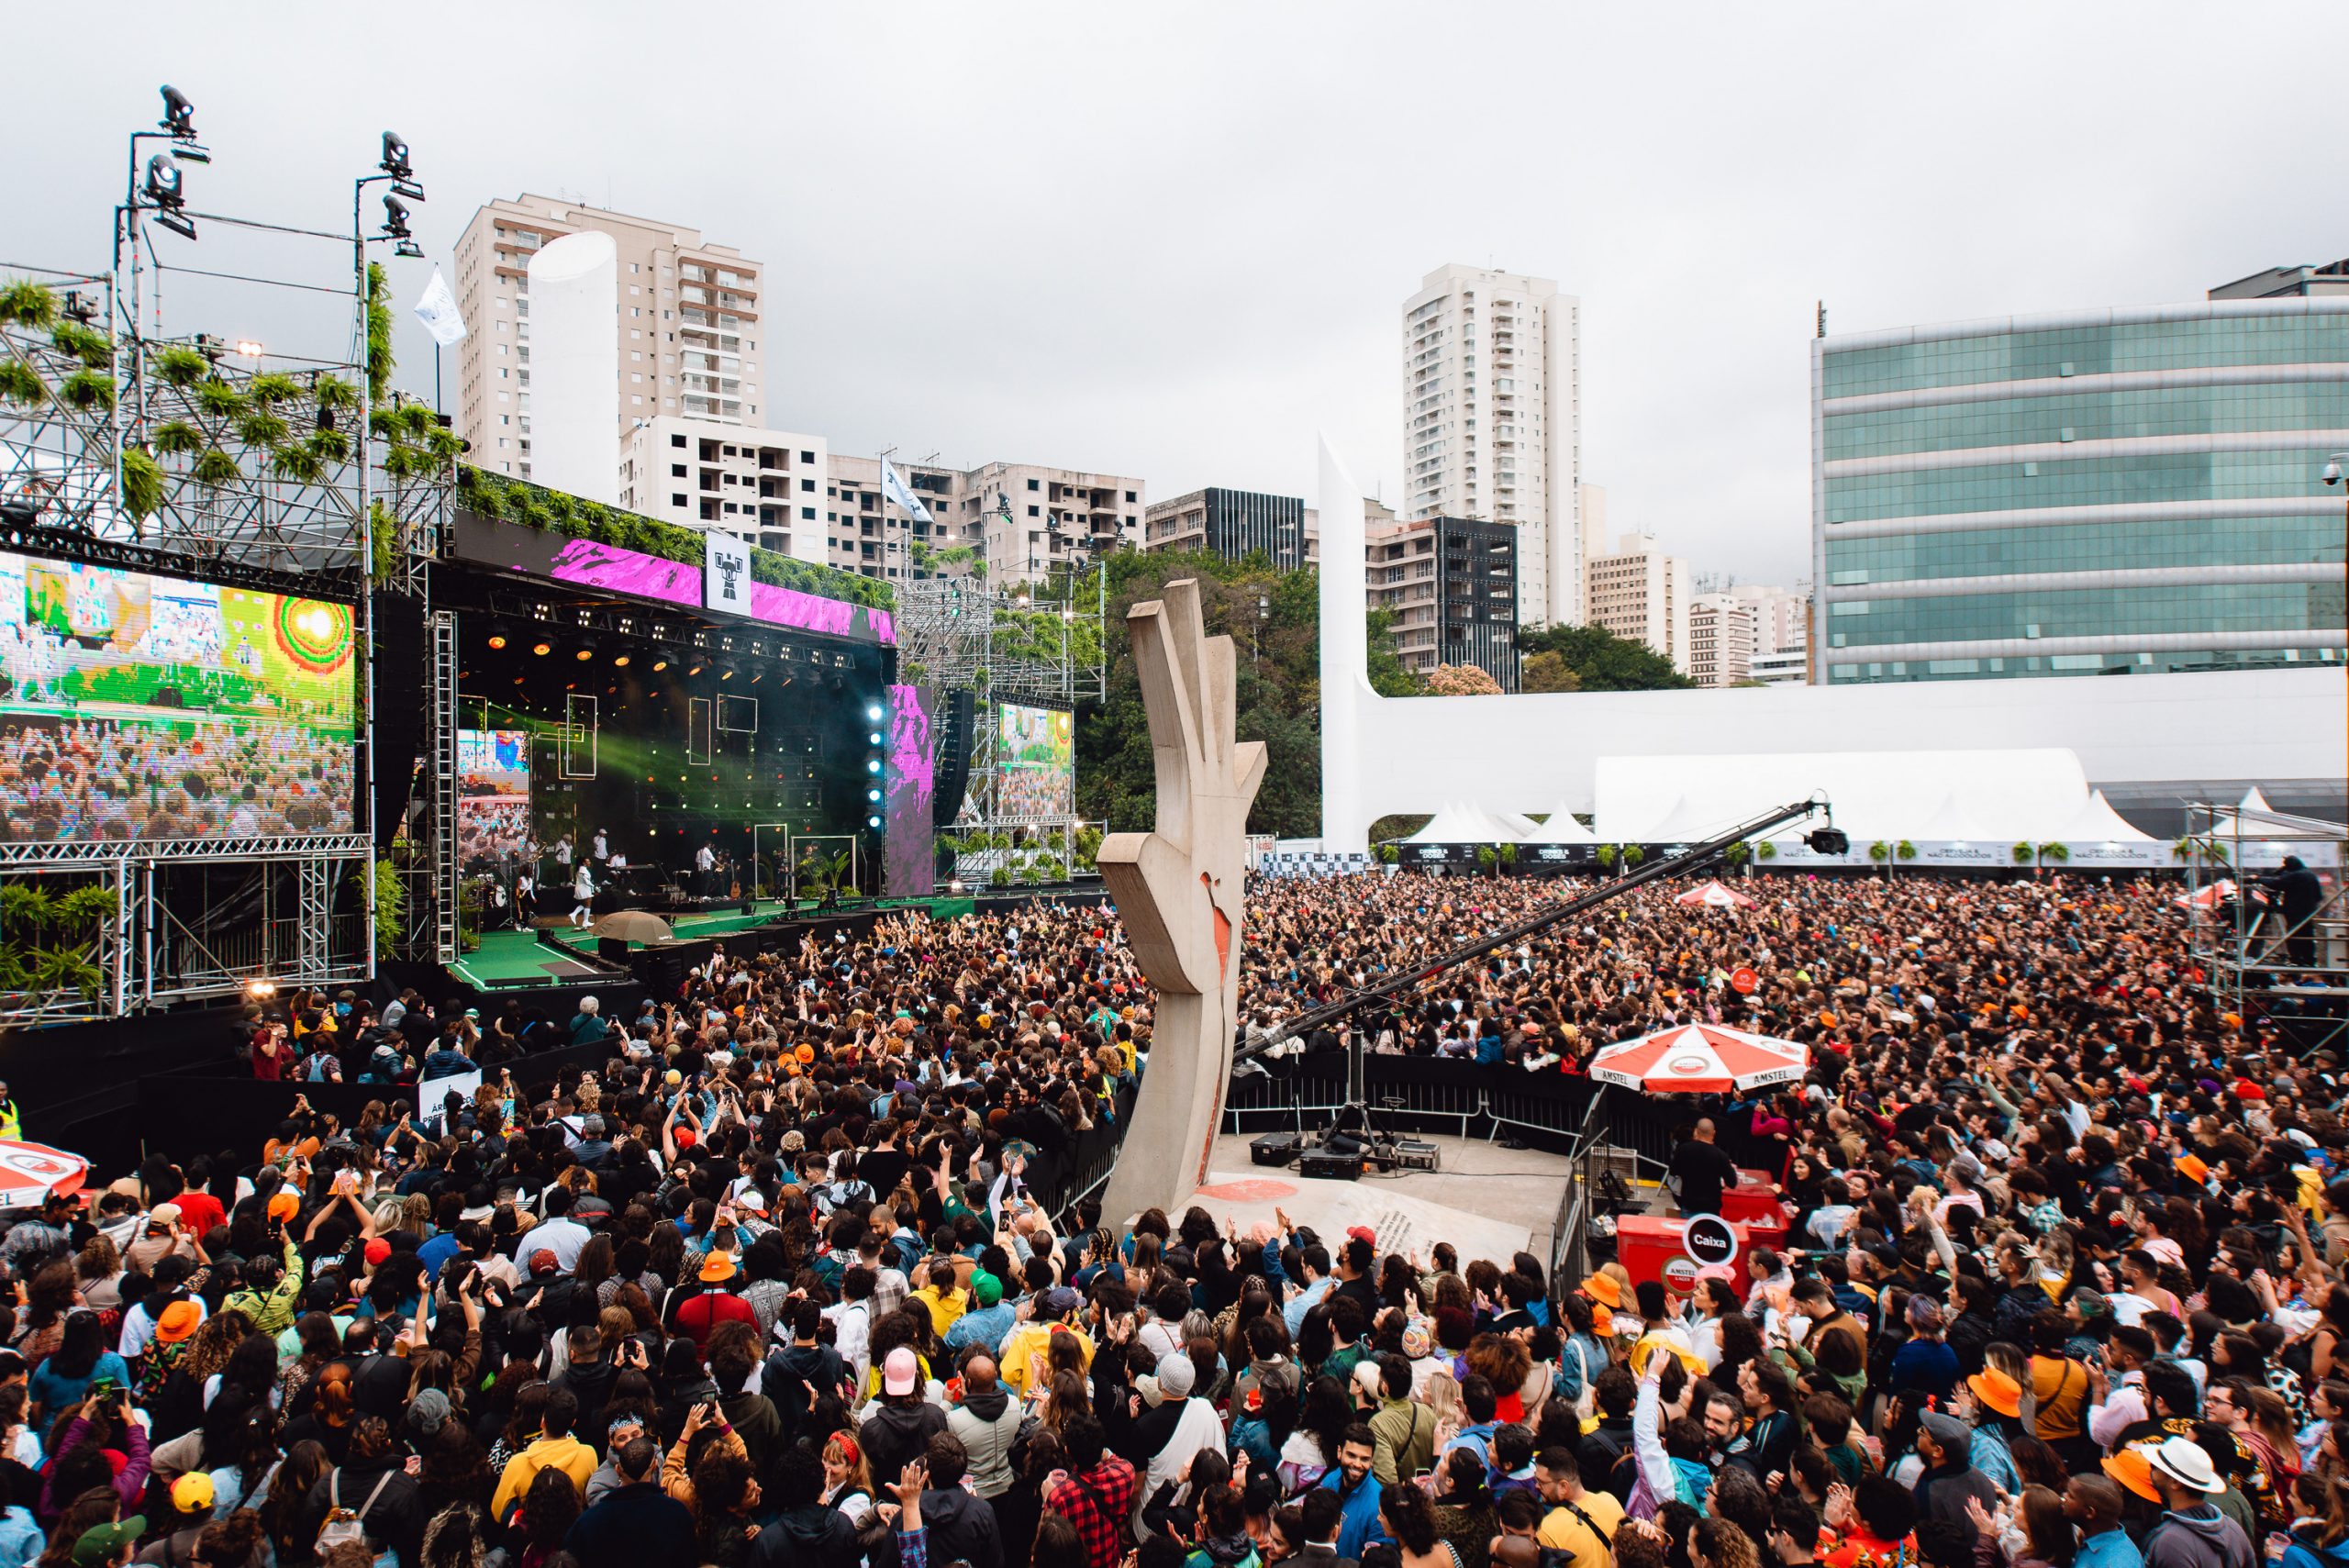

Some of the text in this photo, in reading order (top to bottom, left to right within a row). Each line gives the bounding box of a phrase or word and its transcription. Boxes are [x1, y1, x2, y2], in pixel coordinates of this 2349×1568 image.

[1602, 1070, 1629, 1085] AMSTEL
[1753, 1070, 1788, 1085] AMSTEL
[1694, 1234, 1727, 1249] Caixa
